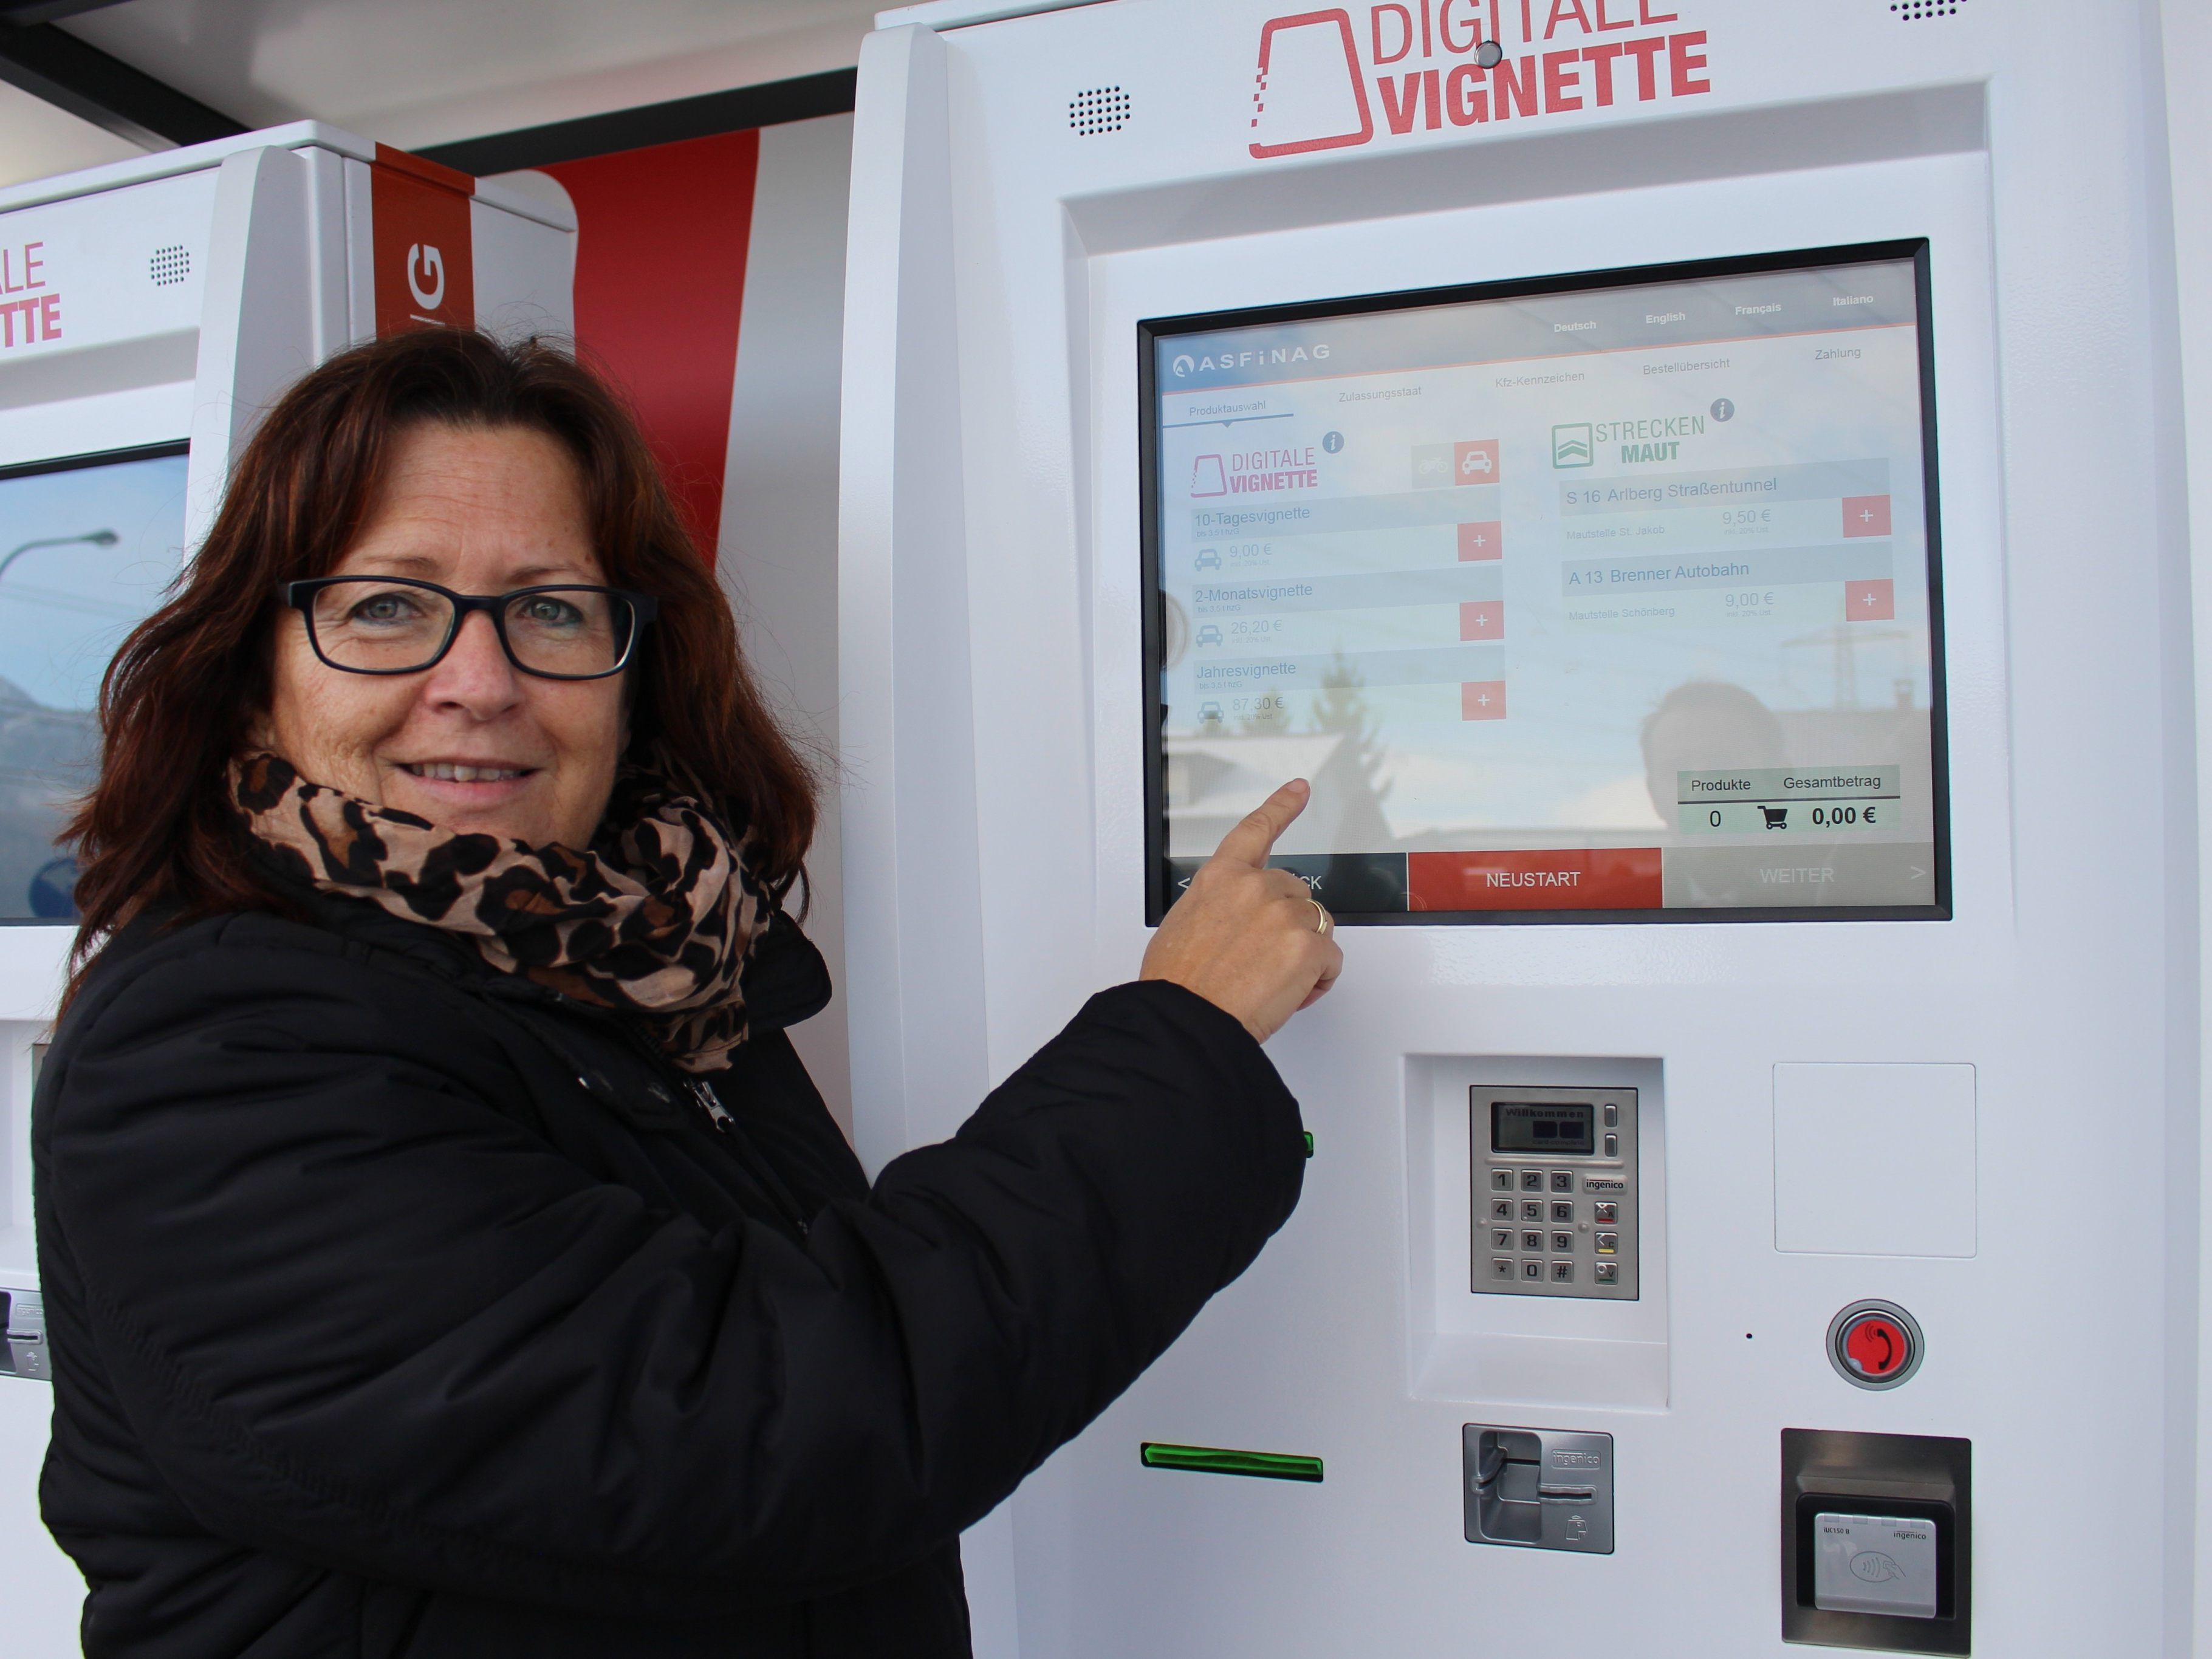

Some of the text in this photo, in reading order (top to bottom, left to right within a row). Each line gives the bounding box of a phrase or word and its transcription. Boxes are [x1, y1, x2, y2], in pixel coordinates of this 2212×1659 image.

[1377, 30, 1711, 135] VIGNETTE
[0, 242, 46, 295] LE
[1832, 295, 1874, 306] Italiano
[1734, 303, 1782, 315] Français
[1645, 312, 1686, 324] English
[1553, 321, 1597, 333] Deutsch
[1814, 347, 1861, 360] Zahlung
[1643, 358, 1730, 375] Bestellübersicht
[1495, 372, 1585, 388] Kfz-Kennzeichen
[1338, 386, 1422, 403] Zulassungsstaat
[1189, 400, 1266, 417] Produktauswahl
[1595, 416, 1705, 442] STRECKEN
[1231, 446, 1316, 472] DIGITALE
[1621, 440, 1680, 463] MAUT
[1230, 468, 1318, 494] VIGNETTE
[1566, 477, 1777, 504] S 16 Arlberg Straßentunnel
[1194, 507, 1310, 527] 10-Tagesvignette
[1722, 508, 1772, 527] 9,50 €
[1566, 528, 1616, 540] Mautstelle
[1635, 525, 1665, 536] Jakob
[1230, 543, 1273, 559] 9,00 €
[1568, 563, 1750, 585] A 13 Brenner Autobahn
[1195, 583, 1313, 602] 2-Monatsvignette
[1725, 591, 1775, 609] 9,00 €
[1569, 607, 1675, 621] Mautstelle Schönberg
[1231, 619, 1283, 635] 26,20 €
[1196, 662, 1296, 679] Jahresvignette
[1274, 696, 1284, 710] €
[1691, 775, 1882, 792] Produkte Gesamtbetrag
[1709, 806, 1877, 828] 0 0,00 €
[1486, 867, 1835, 888] NEUSTART WEITER
[1505, 1107, 1584, 1118] Willkommen
[1497, 1174, 1505, 1186] 1
[1526, 1174, 1538, 1187] 2
[1556, 1175, 1567, 1188] 3
[1586, 1179, 1624, 1190] ingenico
[1496, 1203, 1507, 1216] 4
[1526, 1204, 1538, 1217] 5
[1556, 1205, 1567, 1218] 6
[1497, 1233, 1507, 1246] 7
[1526, 1234, 1538, 1247] 8
[1556, 1236, 1567, 1248] 9
[1526, 1264, 1538, 1277] 0
[1556, 1265, 1567, 1278] #
[1552, 1450, 1600, 1466] ingenico
[1893, 1530, 1926, 1540] ingenico
